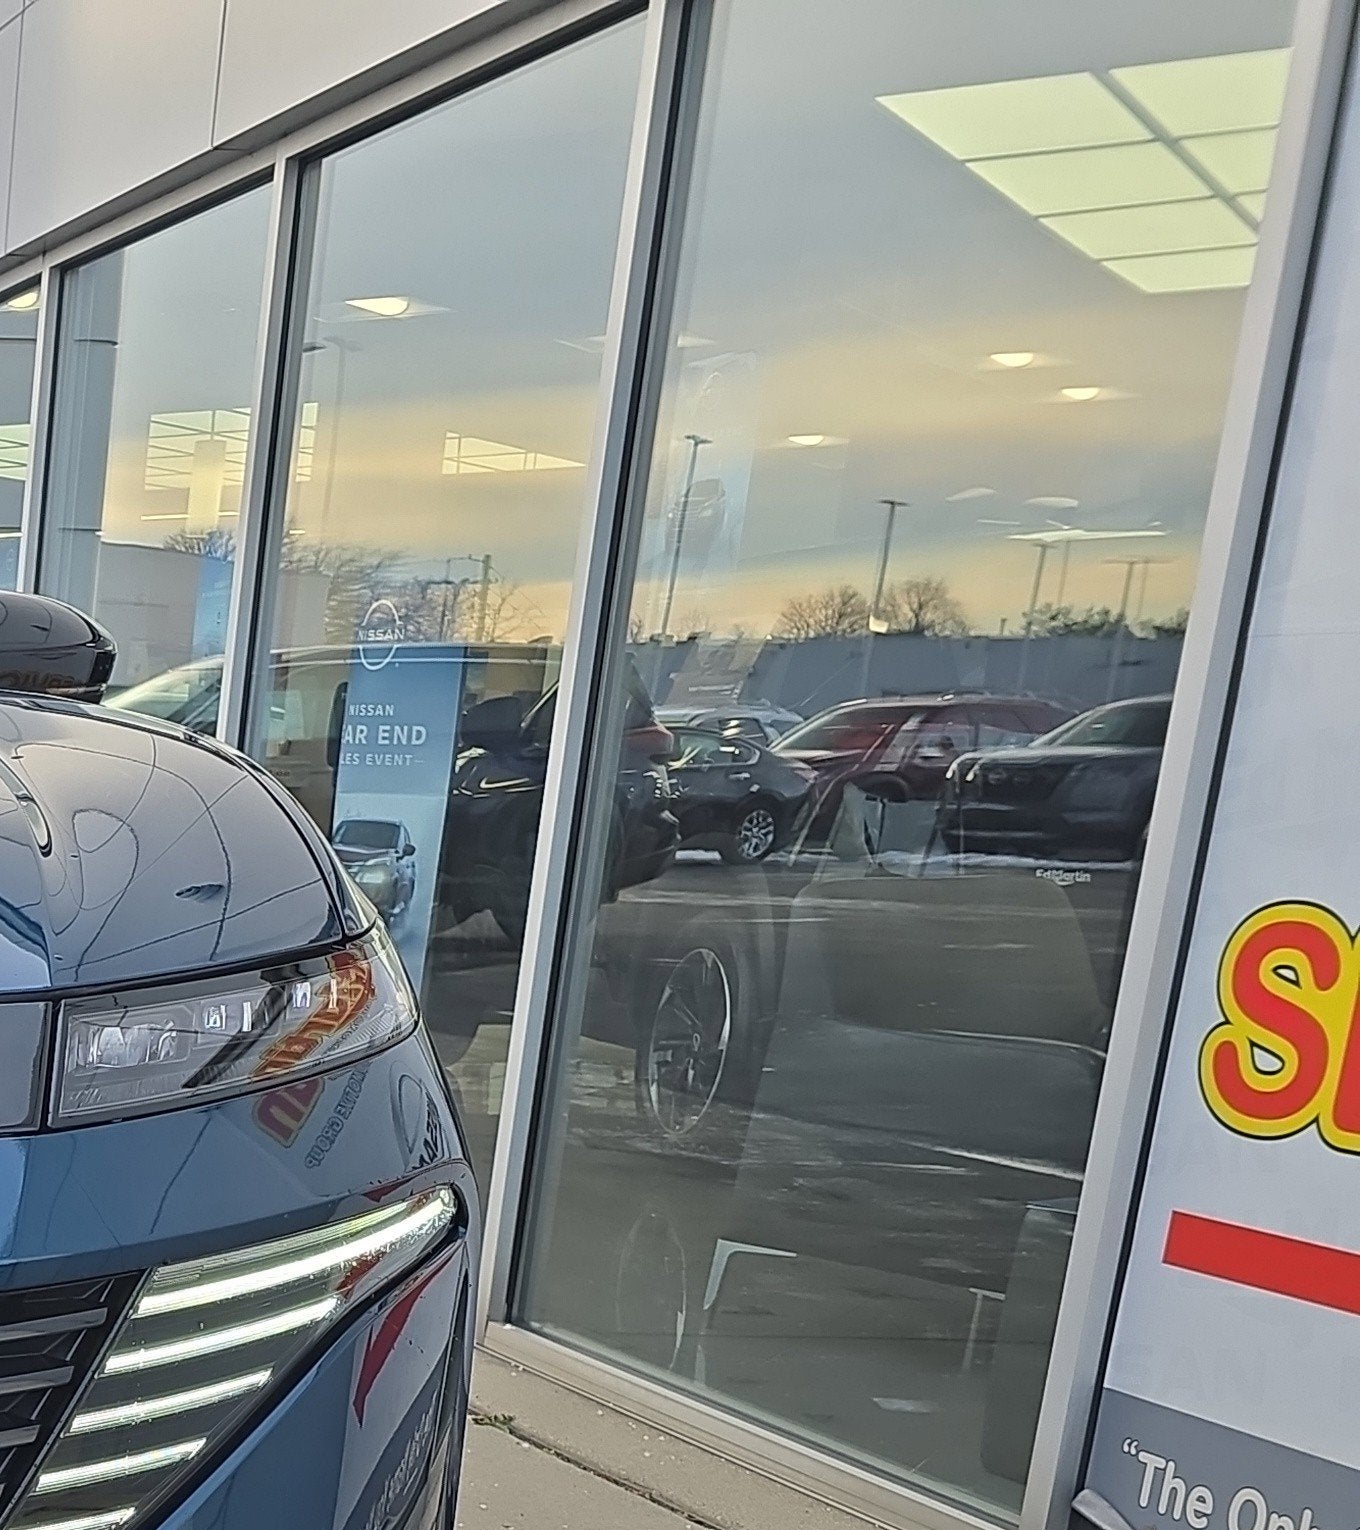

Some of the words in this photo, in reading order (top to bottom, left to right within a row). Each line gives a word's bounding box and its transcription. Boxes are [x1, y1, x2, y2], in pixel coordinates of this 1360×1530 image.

[356, 629, 406, 641] NISSAN
[348, 704, 395, 716] NISSAN
[342, 725, 368, 745] AR
[377, 725, 427, 746] END
[339, 753, 360, 765] LES
[366, 754, 413, 766] EVENT
